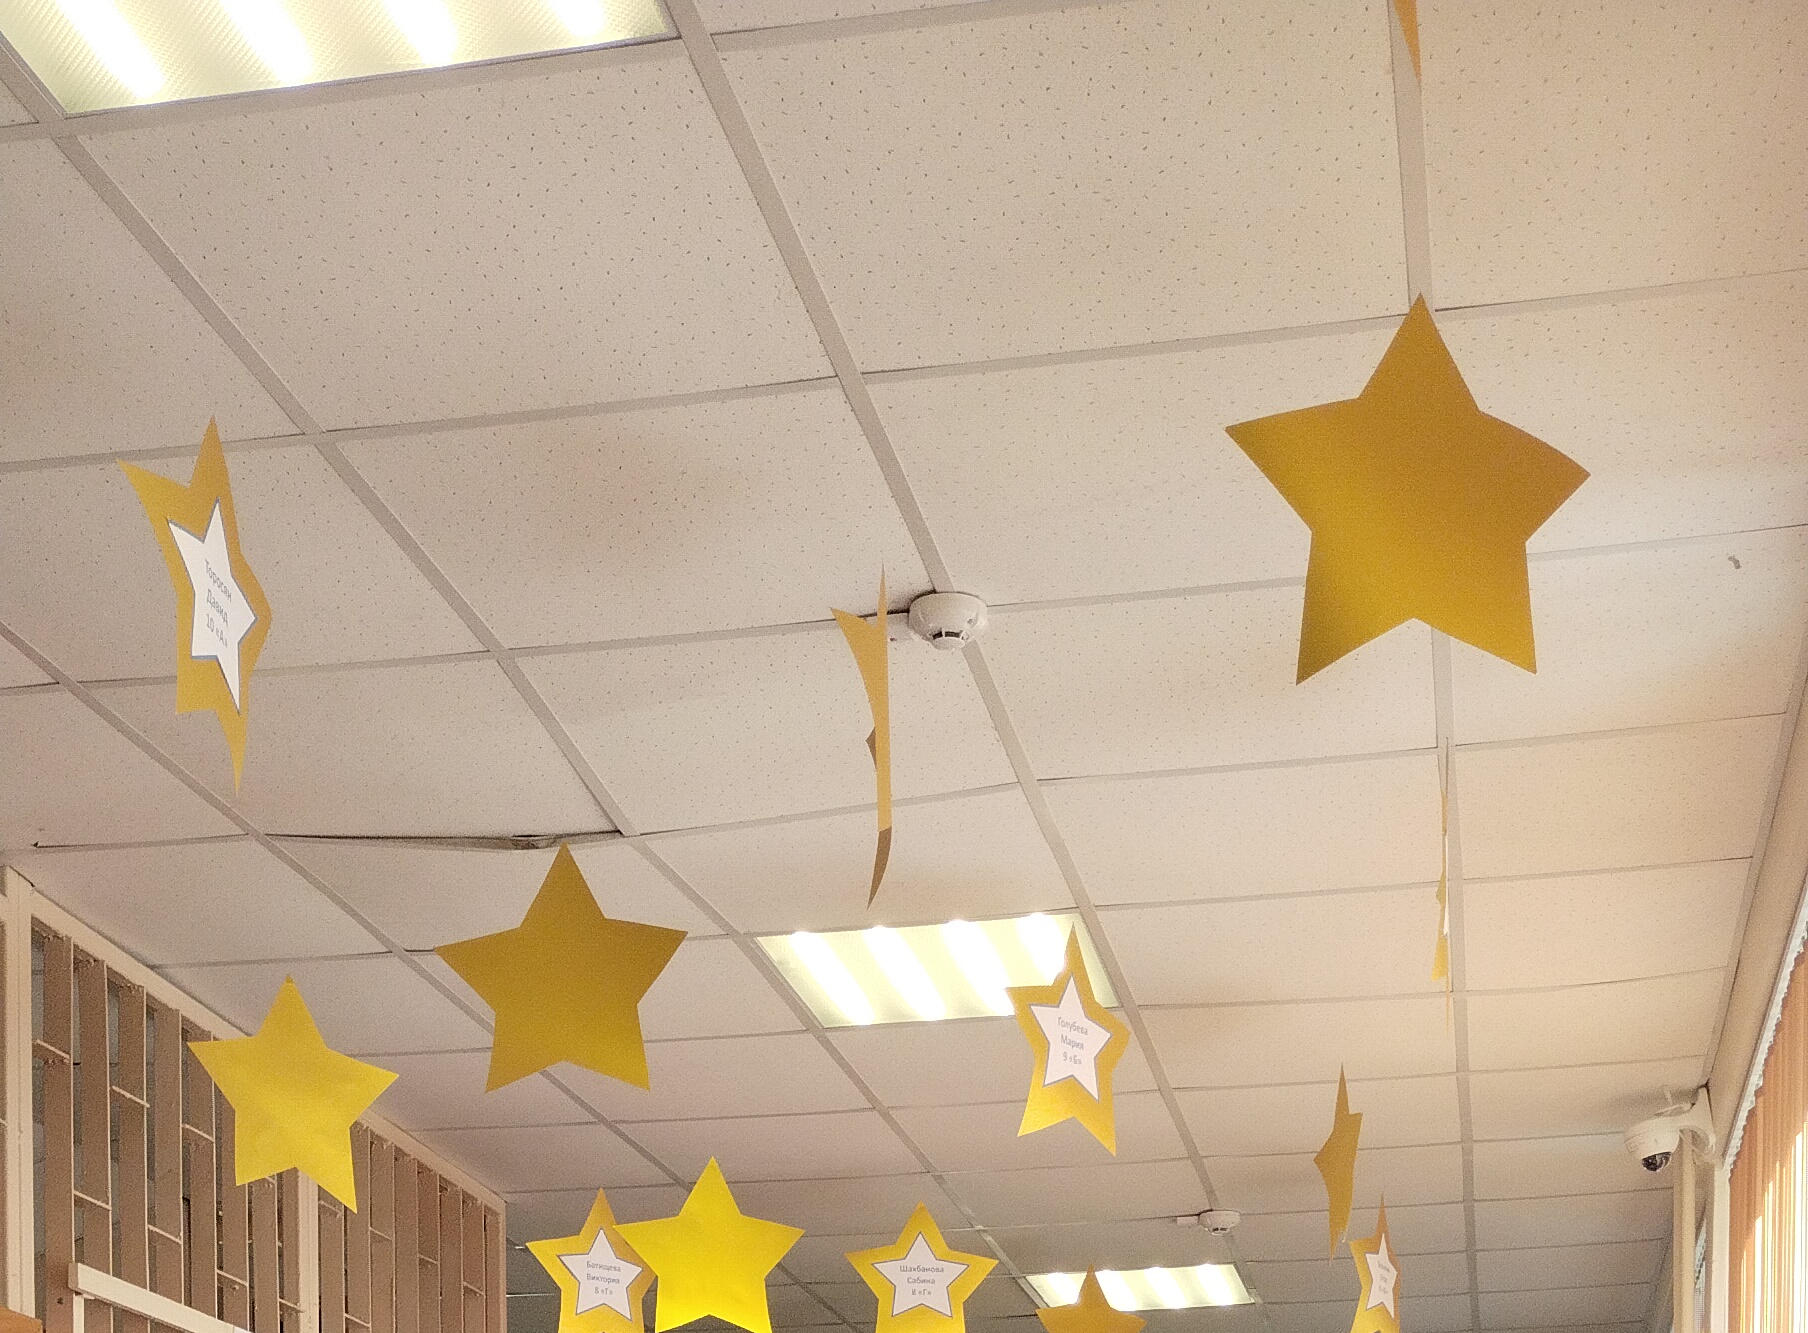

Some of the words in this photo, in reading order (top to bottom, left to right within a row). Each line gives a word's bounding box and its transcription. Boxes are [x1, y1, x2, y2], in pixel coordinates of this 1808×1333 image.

[205, 558, 232, 602] Торосян
[206, 588, 229, 627] Давид
[206, 613, 215, 633] 10
[1057, 1016, 1089, 1036] Голубева
[1060, 1034, 1084, 1051] Мария
[1062, 1051, 1068, 1062] 9
[586, 1260, 622, 1273] Батищева
[899, 1264, 945, 1274] Шахбанова
[586, 1273, 620, 1285] Виктория
[906, 1276, 936, 1285] Сабина
